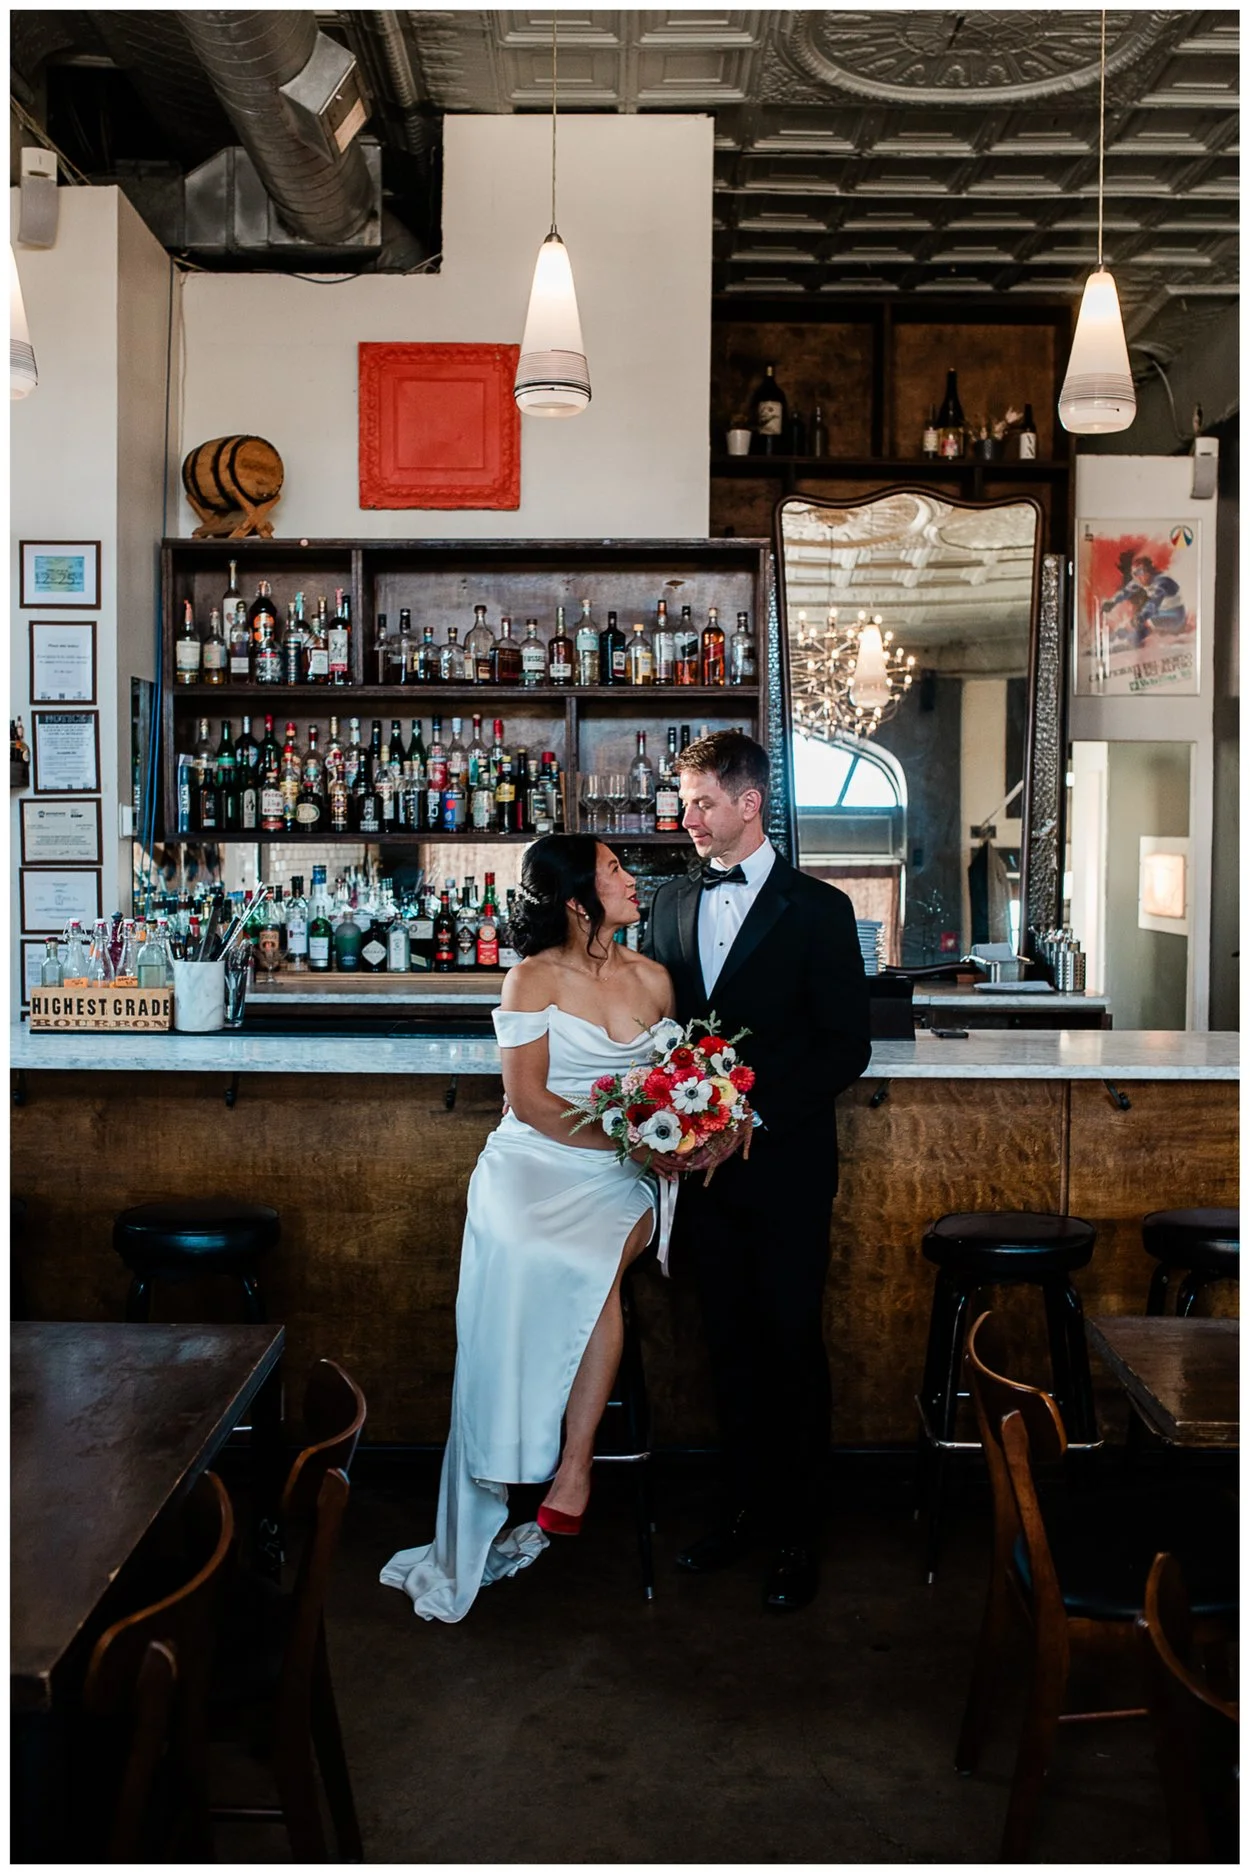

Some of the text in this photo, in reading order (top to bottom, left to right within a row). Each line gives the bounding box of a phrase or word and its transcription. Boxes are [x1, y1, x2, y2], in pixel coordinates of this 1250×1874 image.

[427, 801, 439, 817] 15
[32, 997, 169, 1016] HIGHEST GRADE
[32, 1019, 169, 1027] BOURBON
